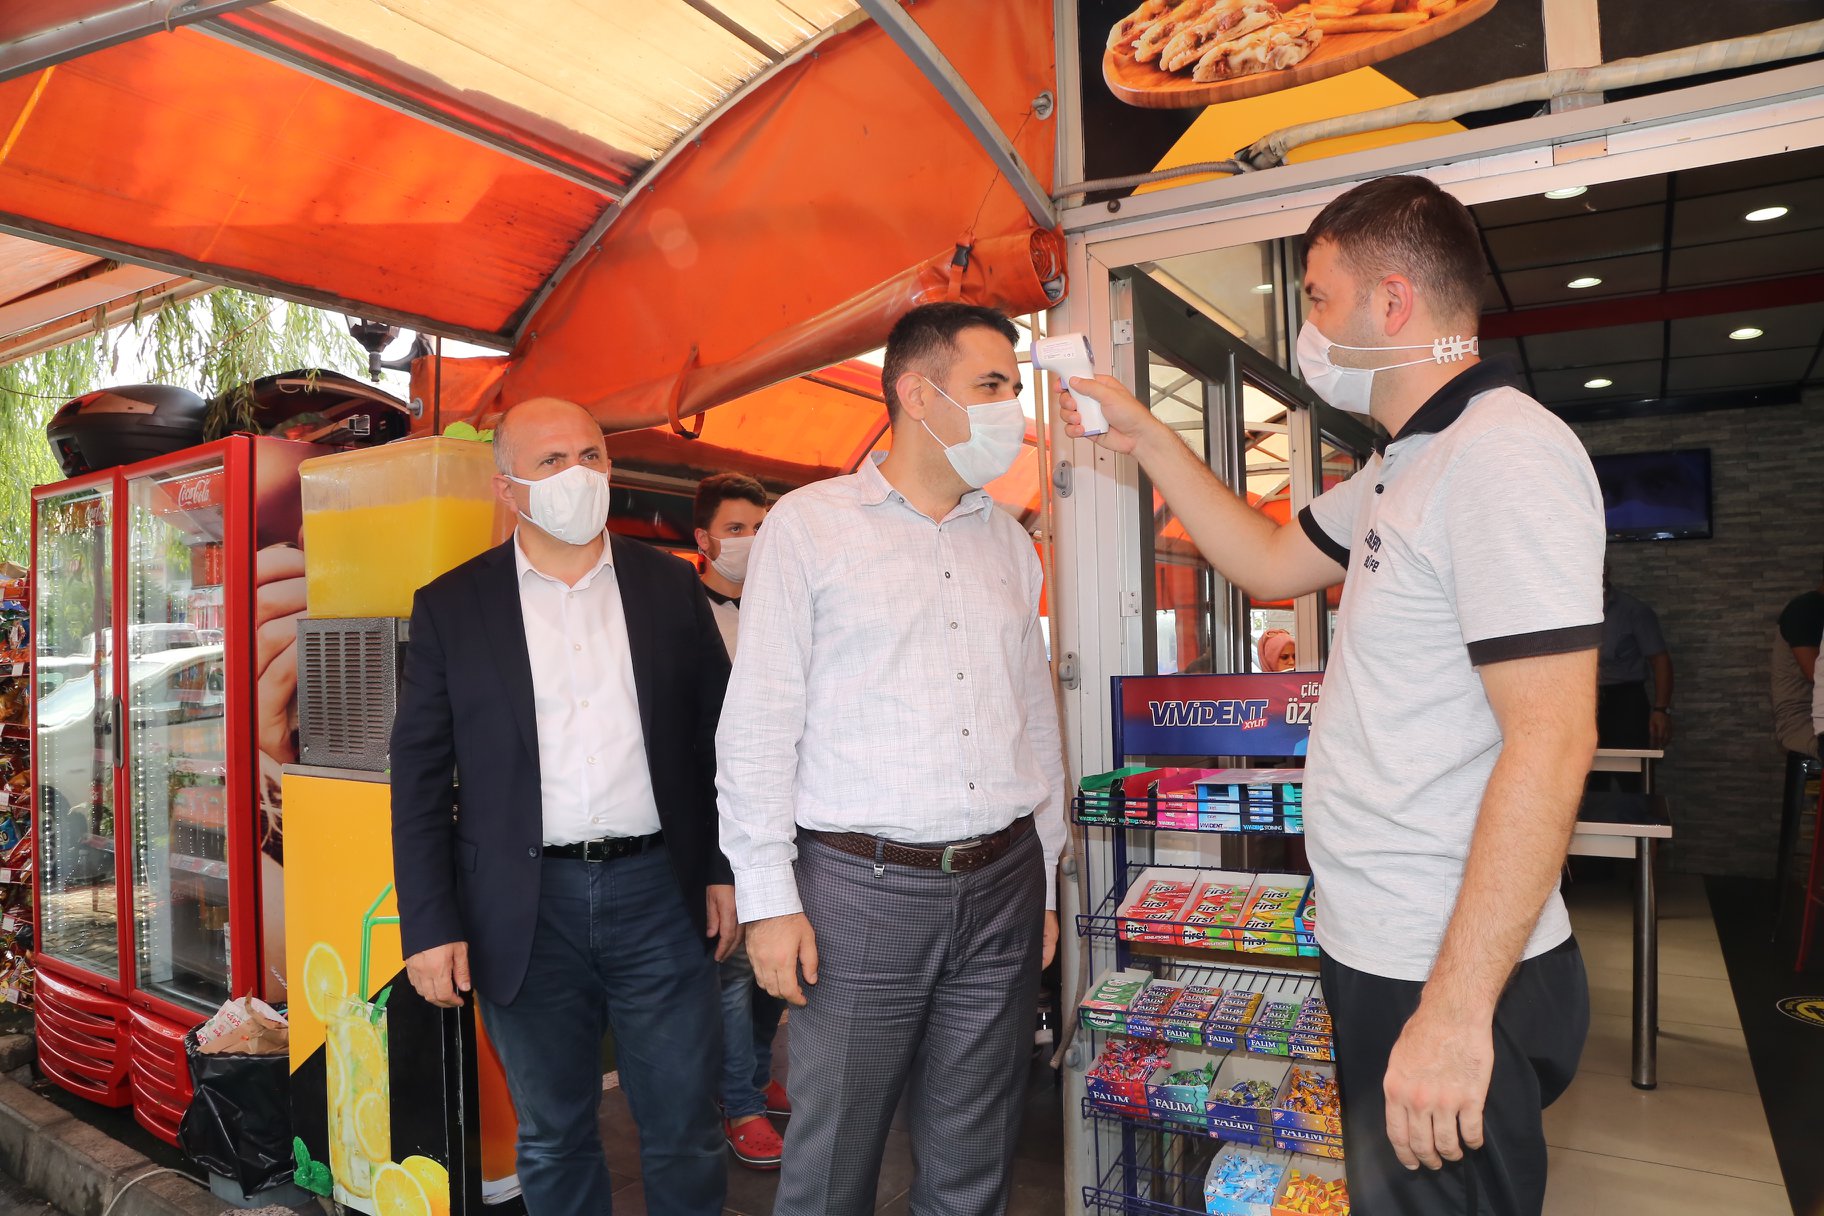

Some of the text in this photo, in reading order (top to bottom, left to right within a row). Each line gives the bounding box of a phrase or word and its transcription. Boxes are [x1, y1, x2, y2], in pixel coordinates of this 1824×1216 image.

[1244, 719, 1267, 730] XYLIT
[1260, 890, 1290, 898] First
[1141, 900, 1170, 908] First
[1196, 904, 1225, 912] First
[1252, 902, 1282, 910] First
[1186, 915, 1215, 923] First
[1244, 920, 1275, 928] First
[1125, 924, 1148, 934] First
[1183, 930, 1207, 940] First
[1242, 936, 1267, 945] First
[1166, 1029, 1190, 1038] FALIM
[1209, 1034, 1234, 1043] FALIM
[1251, 1039, 1276, 1048] FALIM
[1291, 1044, 1318, 1053] FALIM
[1092, 1090, 1130, 1103] FALIM
[1154, 1098, 1194, 1113] FALIM
[1213, 1118, 1255, 1131] FALIM
[1281, 1129, 1324, 1141] FALIM
